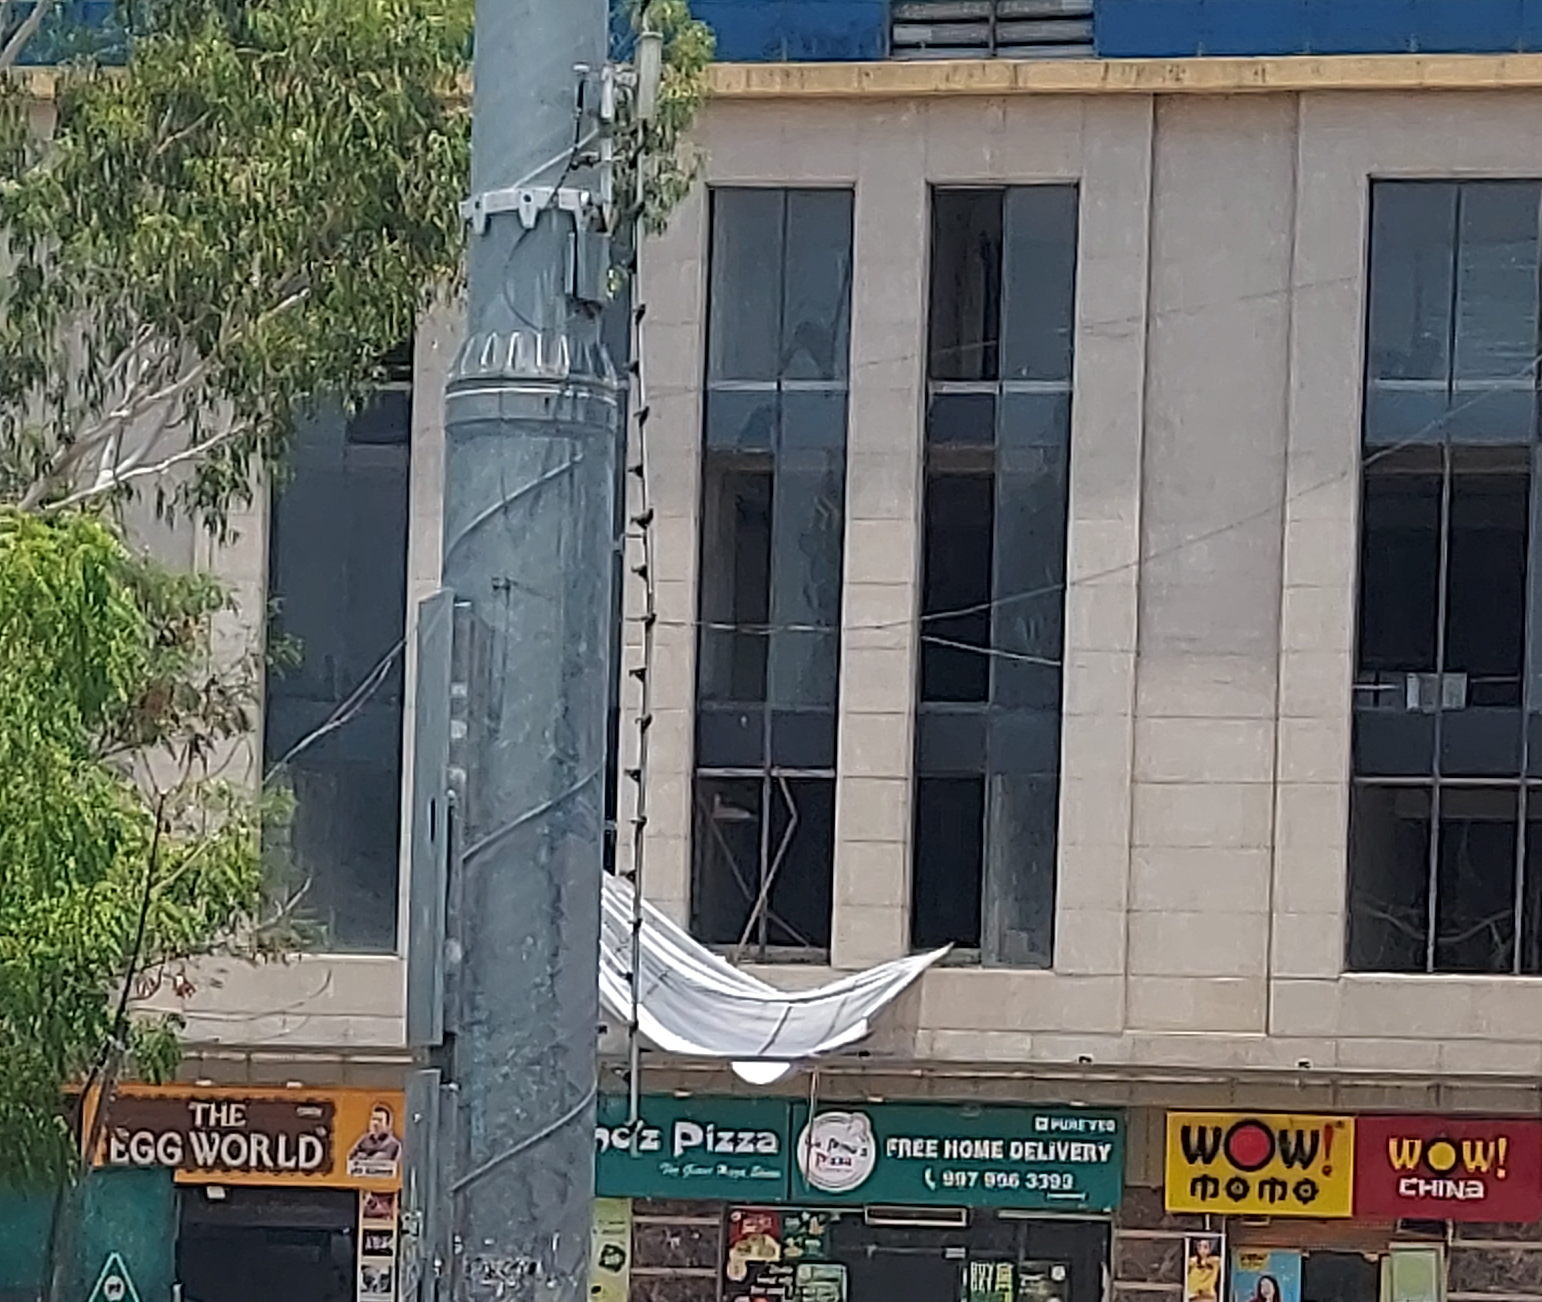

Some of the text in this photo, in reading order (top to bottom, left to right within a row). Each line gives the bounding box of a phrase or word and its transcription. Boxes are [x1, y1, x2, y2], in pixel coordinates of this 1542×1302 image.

[188, 1101, 247, 1127] THE
[110, 1128, 324, 1169] EGG WORLD
[673, 1120, 780, 1158] Pizza
[886, 1137, 939, 1159] FREE
[943, 1139, 1005, 1160] HOME
[1009, 1140, 1112, 1163] DELIVERY
[1180, 1119, 1335, 1178] WOW!
[1387, 1135, 1508, 1179] WOW!
